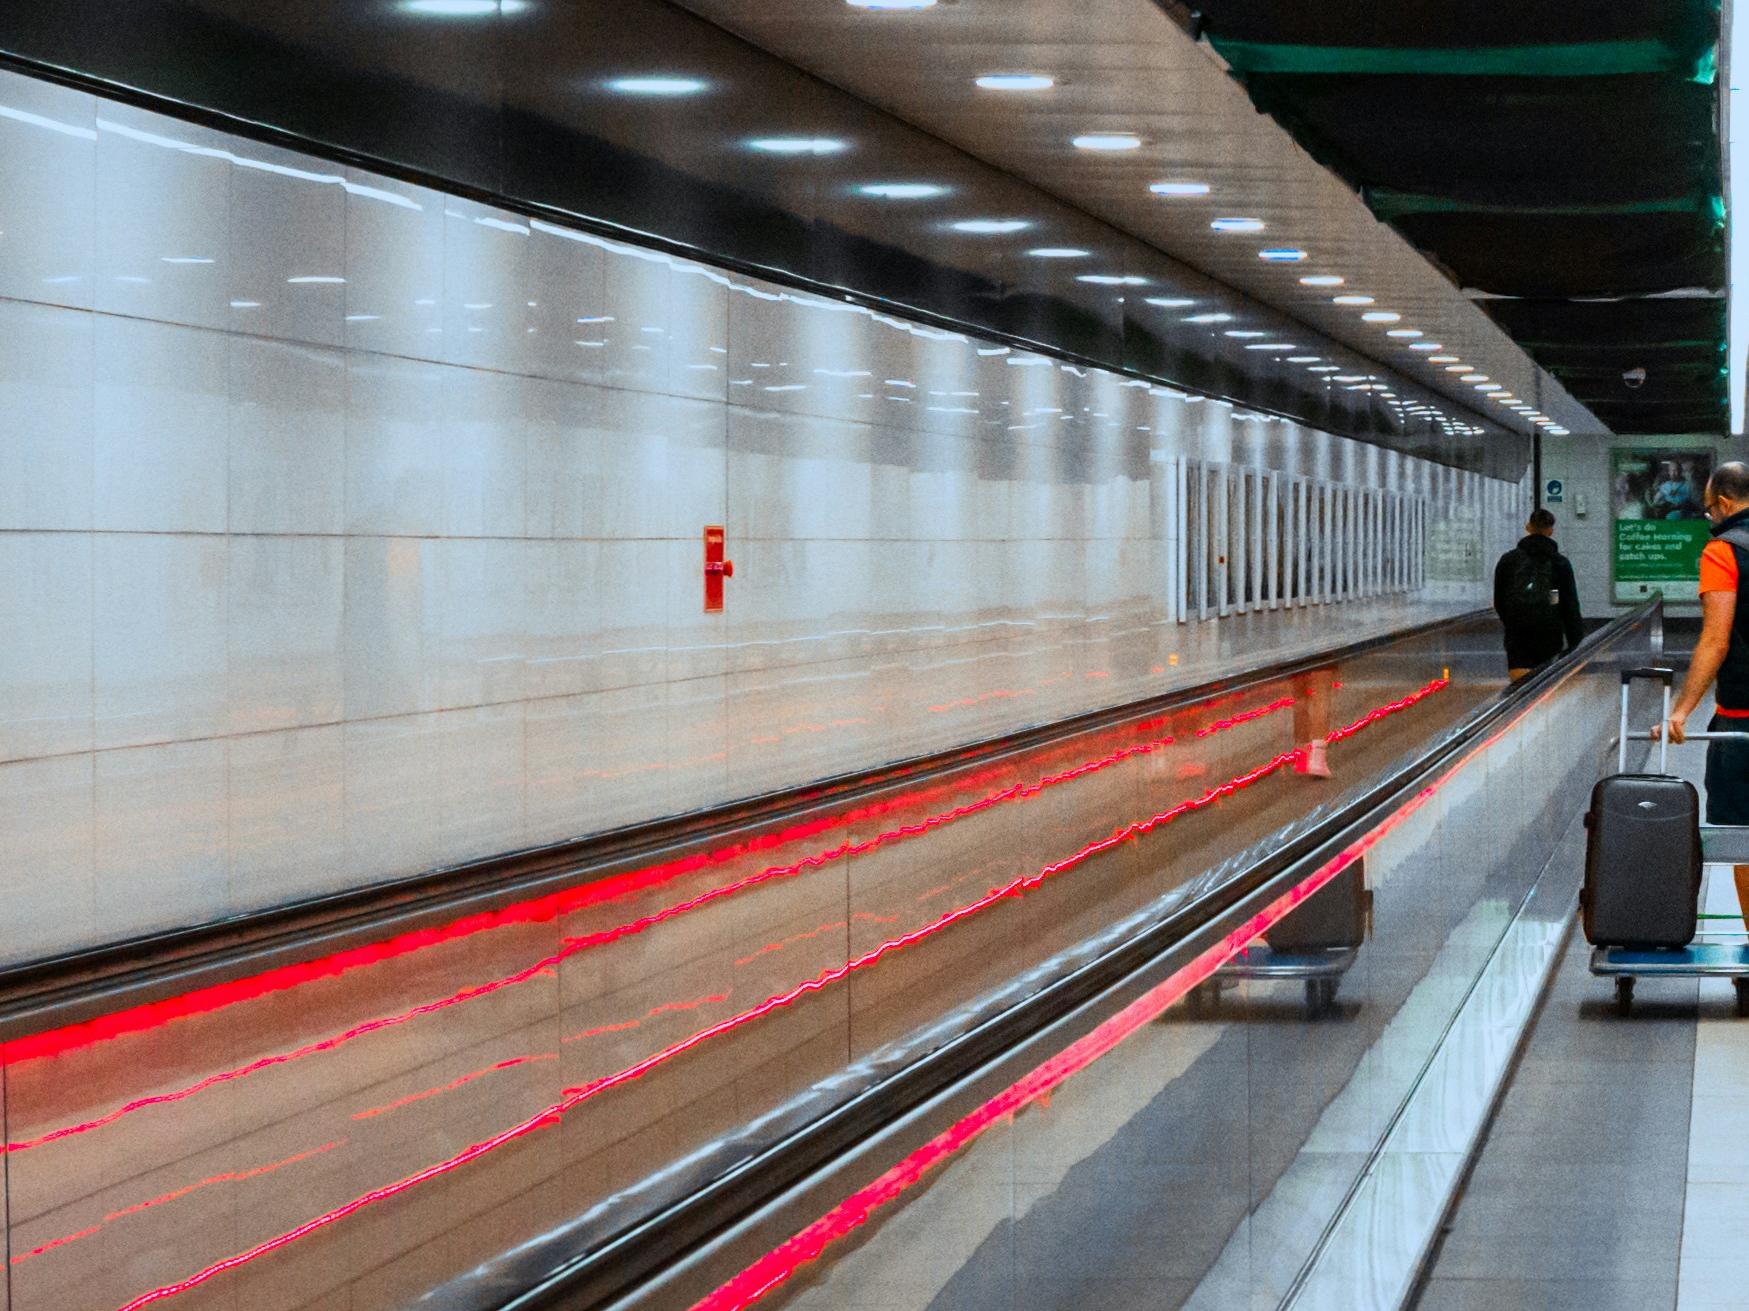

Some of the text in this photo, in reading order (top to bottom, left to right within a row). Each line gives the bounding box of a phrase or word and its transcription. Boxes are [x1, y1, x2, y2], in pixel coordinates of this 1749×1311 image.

[1644, 522, 1656, 531] do
[1619, 532, 1692, 542] Coffee Morning
[1619, 542, 1682, 550] for cakes and
[1619, 552, 1645, 560] catch
